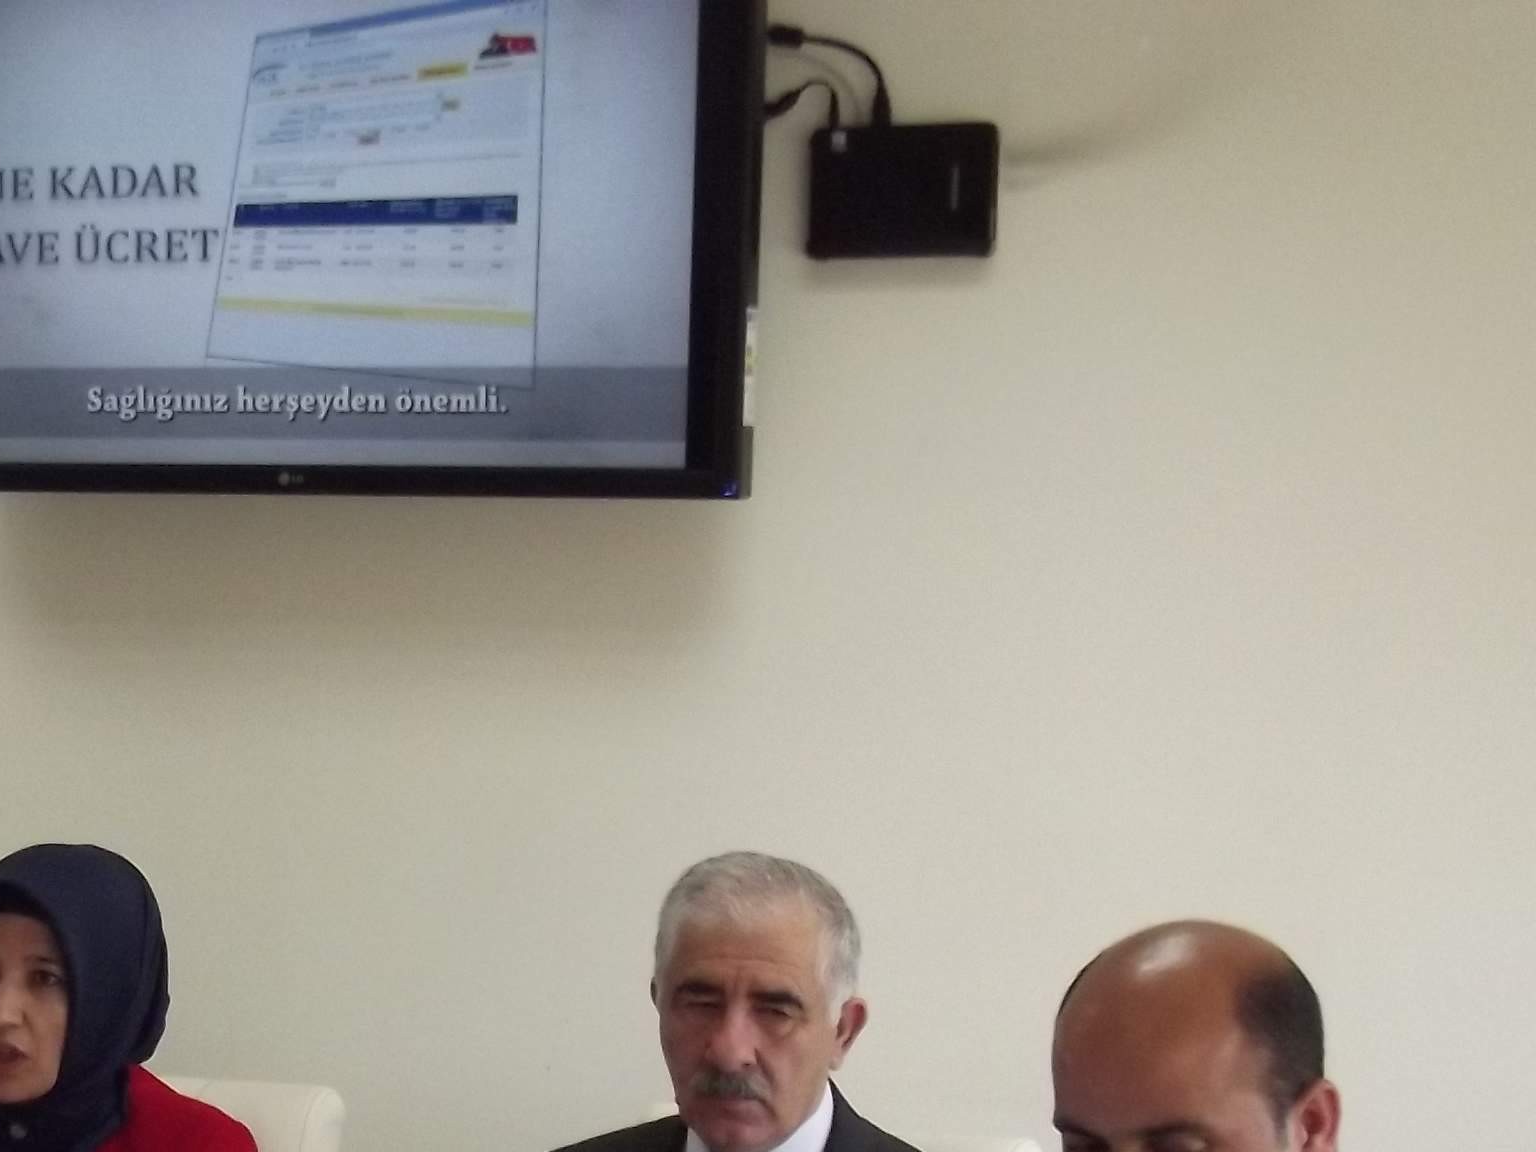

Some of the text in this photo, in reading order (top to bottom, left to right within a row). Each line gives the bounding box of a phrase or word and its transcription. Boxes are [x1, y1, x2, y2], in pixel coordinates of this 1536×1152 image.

[49, 163, 200, 200] KADAR
[75, 223, 220, 264] ÜCRET
[87, 384, 510, 422] Sağlığınız herşeyden önemli.
